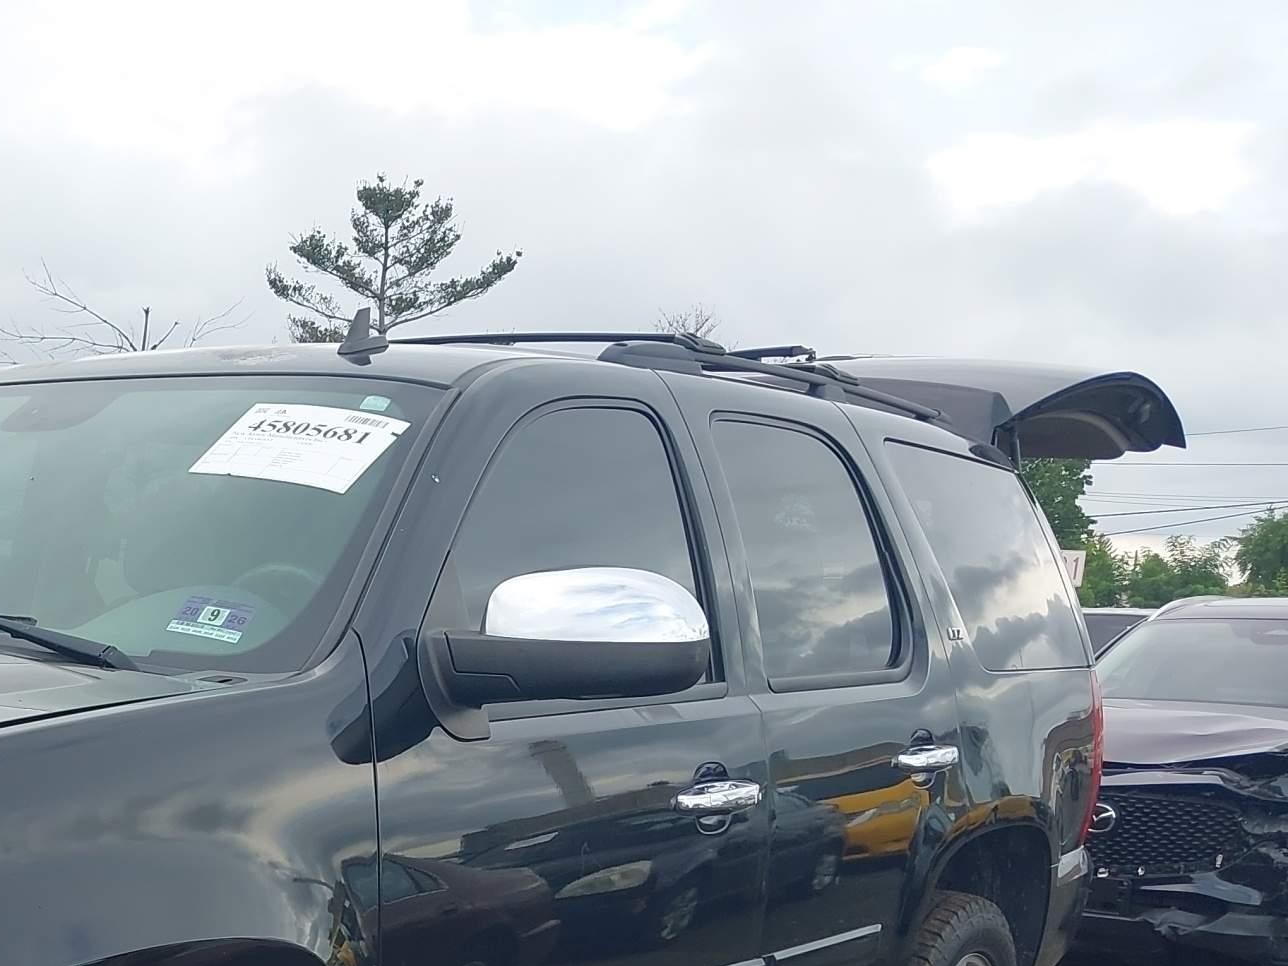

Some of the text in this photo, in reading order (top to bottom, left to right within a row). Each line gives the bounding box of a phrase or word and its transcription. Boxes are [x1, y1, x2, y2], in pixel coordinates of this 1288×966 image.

[248, 418, 372, 445] 45805681
[208, 608, 221, 622] 9
[228, 614, 248, 625] 26
